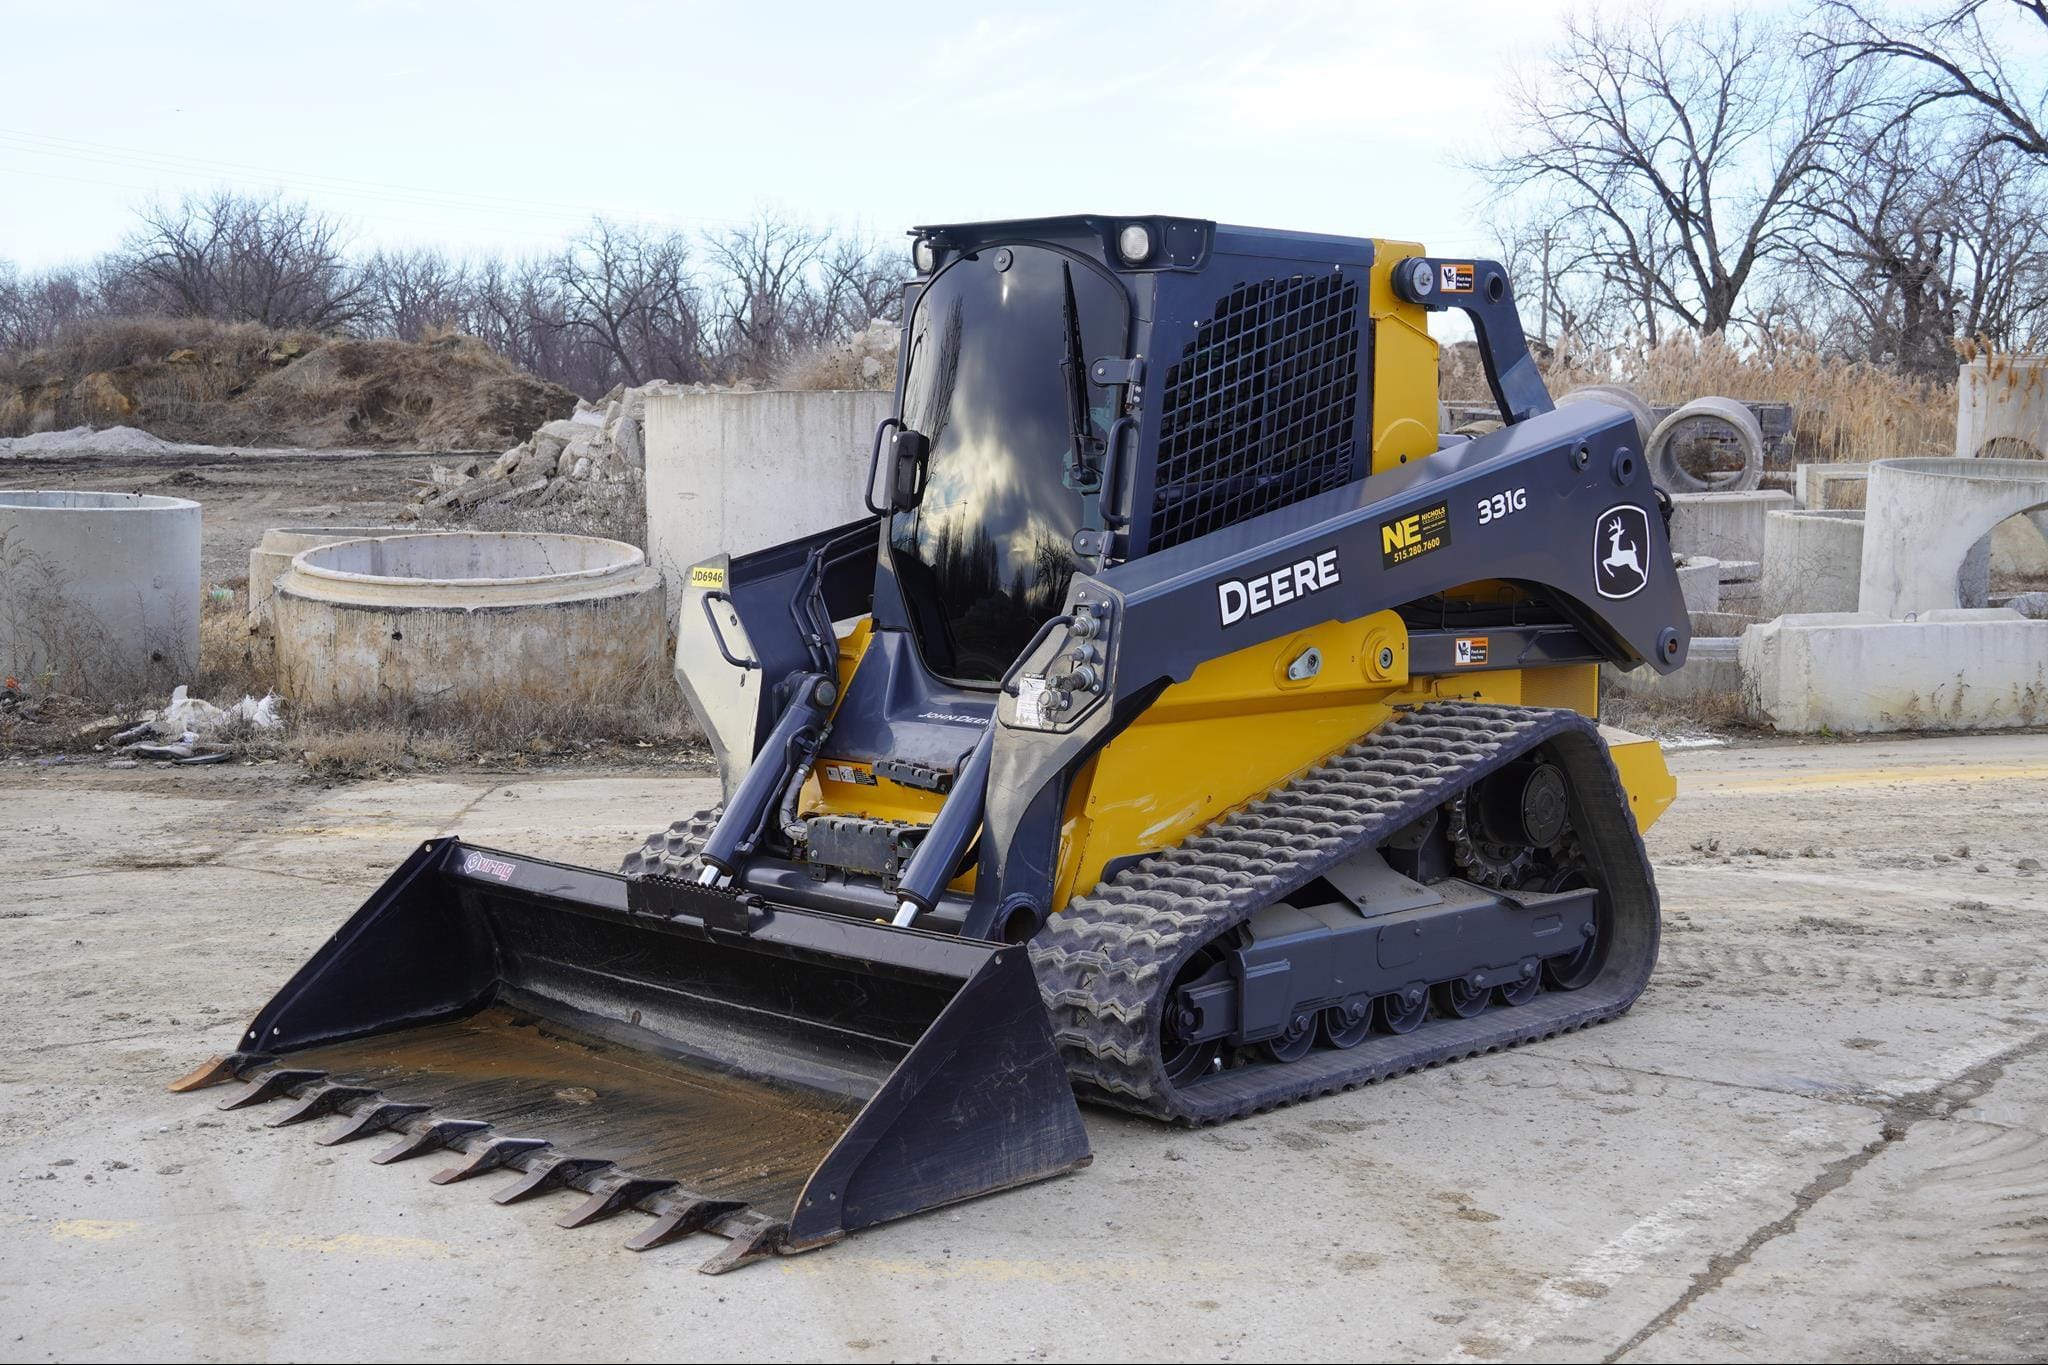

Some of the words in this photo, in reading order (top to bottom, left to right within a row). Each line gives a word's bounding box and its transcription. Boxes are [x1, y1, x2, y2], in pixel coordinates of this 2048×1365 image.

[1422, 506, 1446, 520] NICHOLS
[1478, 488, 1526, 524] 331G
[1382, 514, 1422, 554] NE
[1394, 537, 1441, 562] 515.280.7600
[692, 570, 723, 583] JD6946
[1218, 549, 1339, 626] DEERE
[918, 711, 957, 721] JOHN
